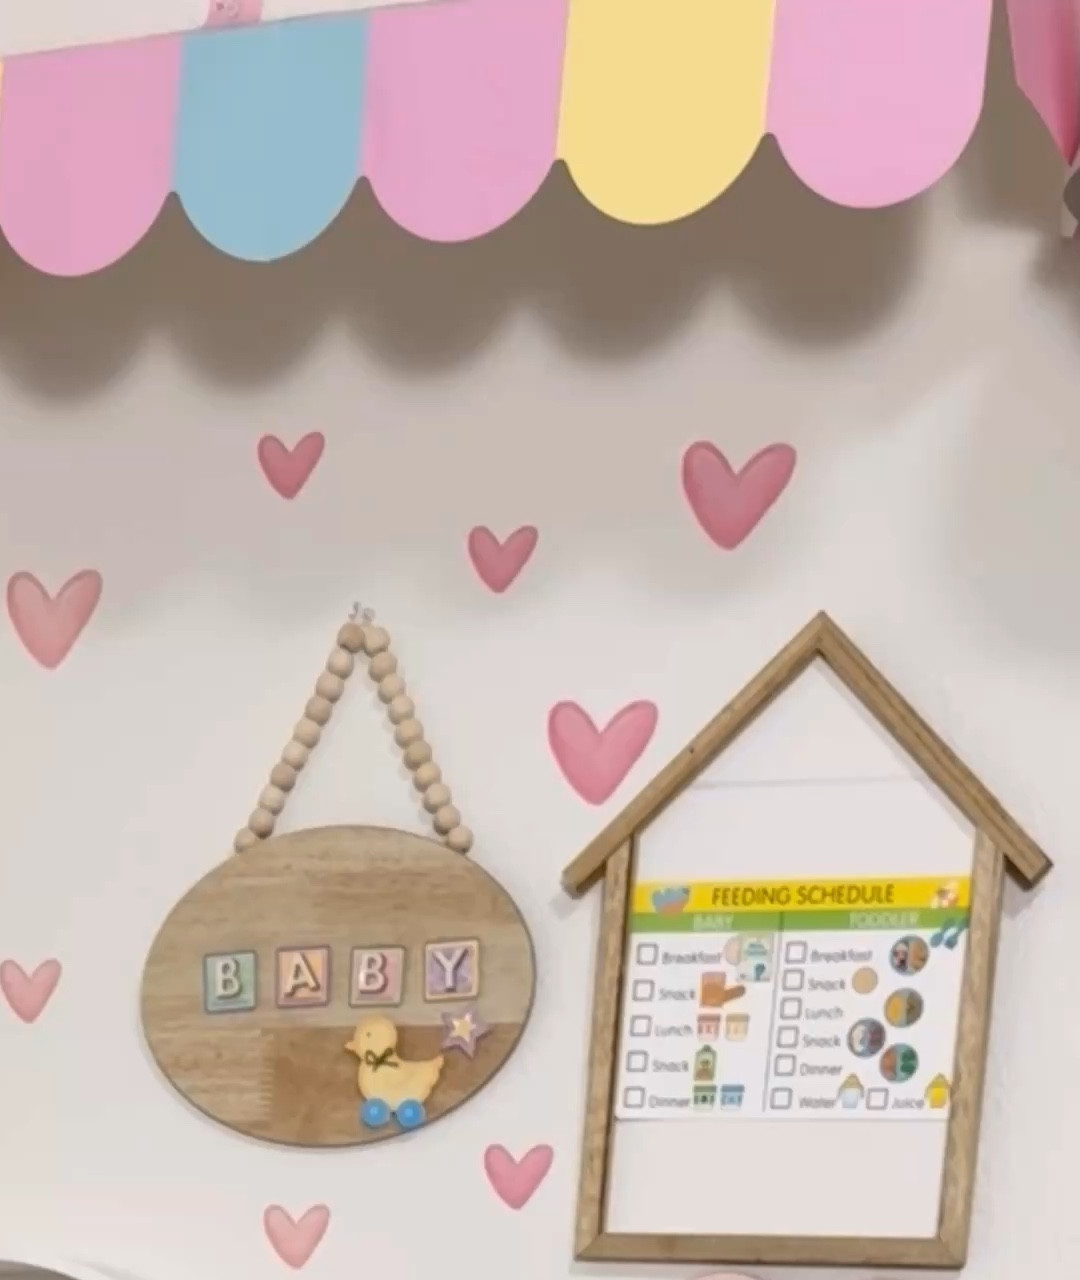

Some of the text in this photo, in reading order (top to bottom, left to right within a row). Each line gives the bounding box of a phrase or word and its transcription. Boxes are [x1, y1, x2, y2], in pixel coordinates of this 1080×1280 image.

[711, 884, 895, 908] FEEDING SCHEDULE
[693, 914, 734, 930] BABY
[849, 912, 919, 929] TODDLER
[662, 951, 722, 965] Breakfast
[811, 949, 873, 963] Breakfast
[214, 948, 469, 999] BABY
[808, 978, 845, 991] Snack
[658, 988, 695, 1001] Snack
[805, 1006, 843, 1020] Lunch
[655, 1024, 693, 1037] Lunch
[803, 1034, 841, 1048] Snack
[652, 1059, 689, 1073] Snack
[799, 1063, 843, 1076] Dinner
[649, 1095, 691, 1108] Dinner
[799, 1096, 837, 1109] Water
[892, 1096, 925, 1109] Juice
